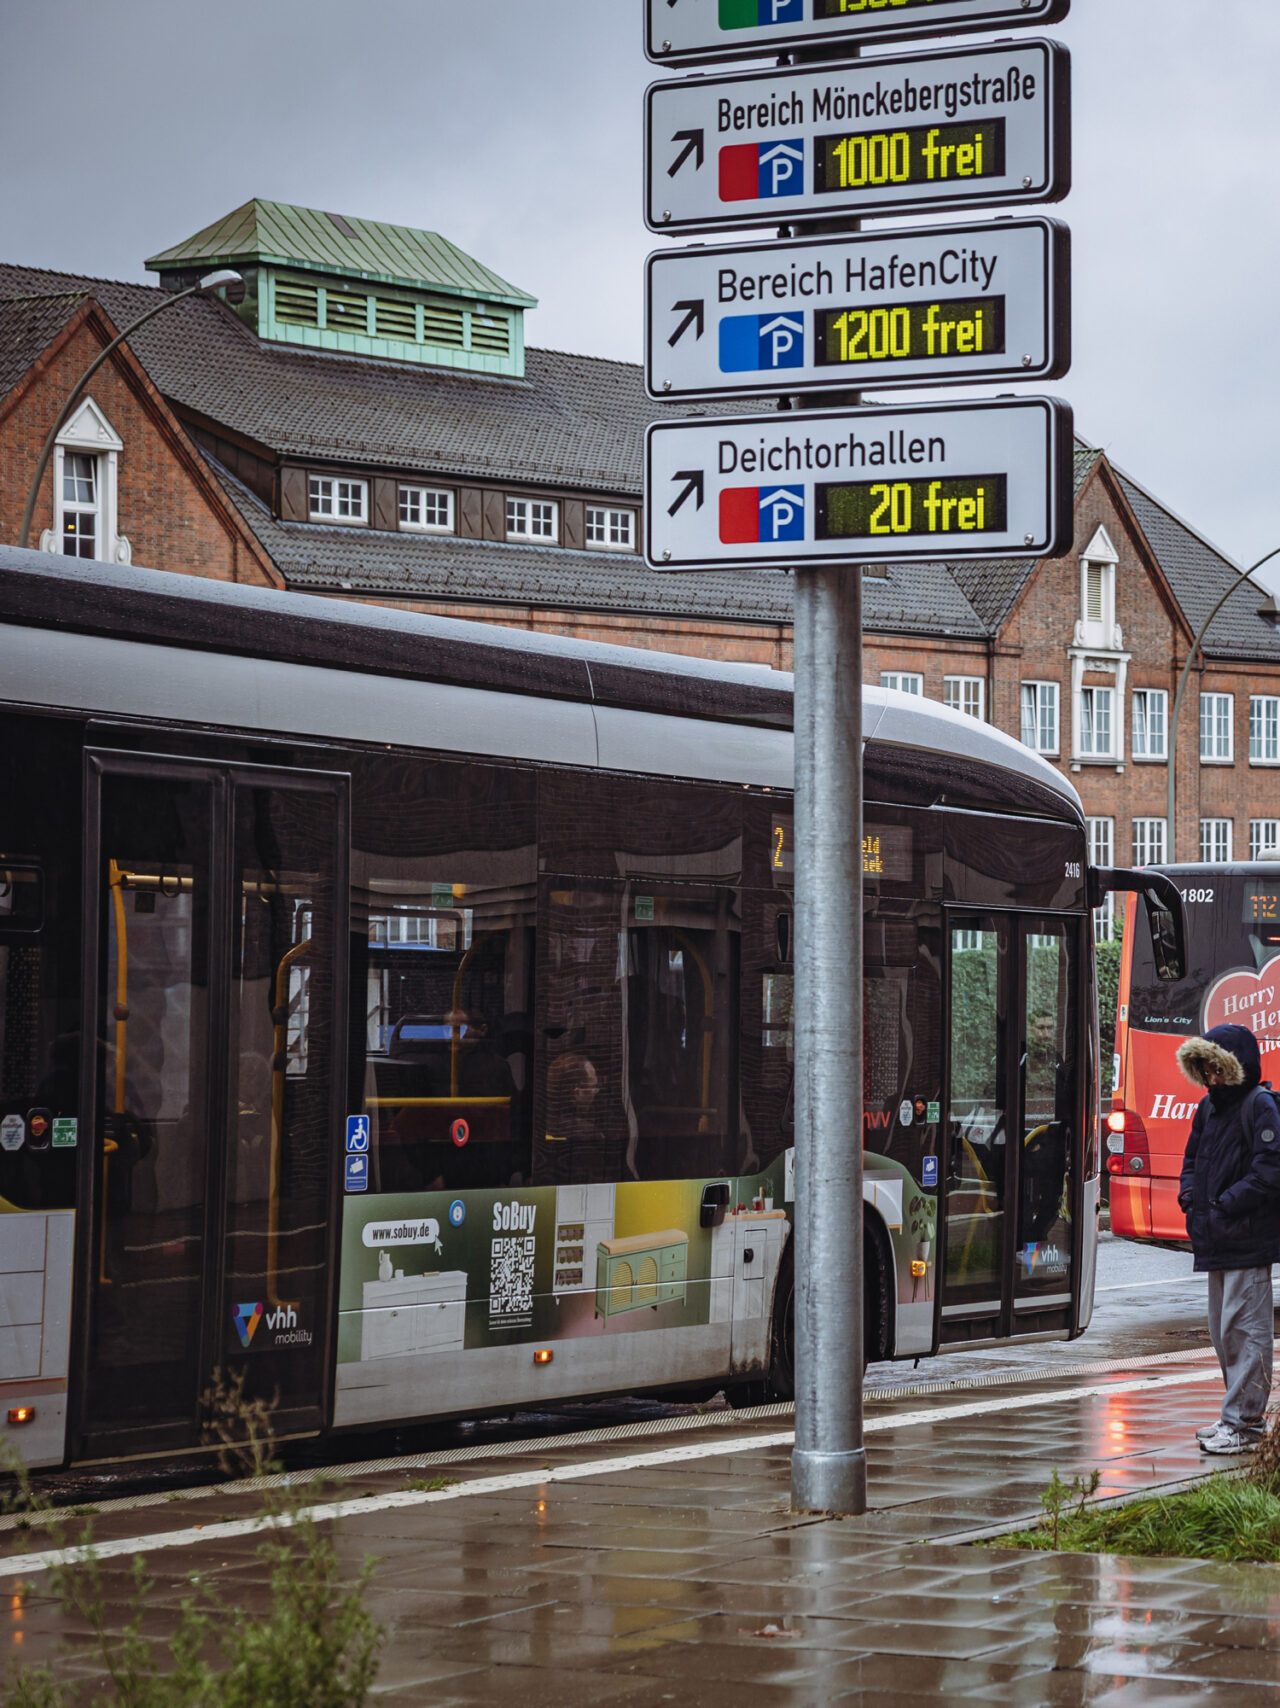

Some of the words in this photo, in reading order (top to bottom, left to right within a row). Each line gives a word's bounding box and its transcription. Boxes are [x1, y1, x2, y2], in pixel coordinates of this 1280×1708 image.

[718, 89, 803, 132] Bereich
[812, 66, 1036, 122] Mönckebergstraße
[832, 132, 909, 187] 1000
[921, 128, 983, 179] frei
[718, 261, 832, 302] Bereich
[845, 248, 997, 292] HafenCity
[833, 307, 910, 361] 1200
[922, 305, 983, 355] frei
[718, 430, 946, 474] Deichtorhallen
[870, 483, 911, 534] 20
[923, 481, 984, 531] frei
[1064, 862, 1080, 878] 2416
[1181, 889, 1214, 902] 1802
[1224, 984, 1275, 1017] Harry
[1144, 1016, 1169, 1024] Lion's
[1172, 1016, 1193, 1025] City
[372, 1222, 430, 1242] www.sobuy.de
[492, 1201, 537, 1234] SoBuy
[1041, 1244, 1059, 1263] vhh
[266, 1304, 297, 1330] vhh
[275, 1329, 313, 1345] mobility
